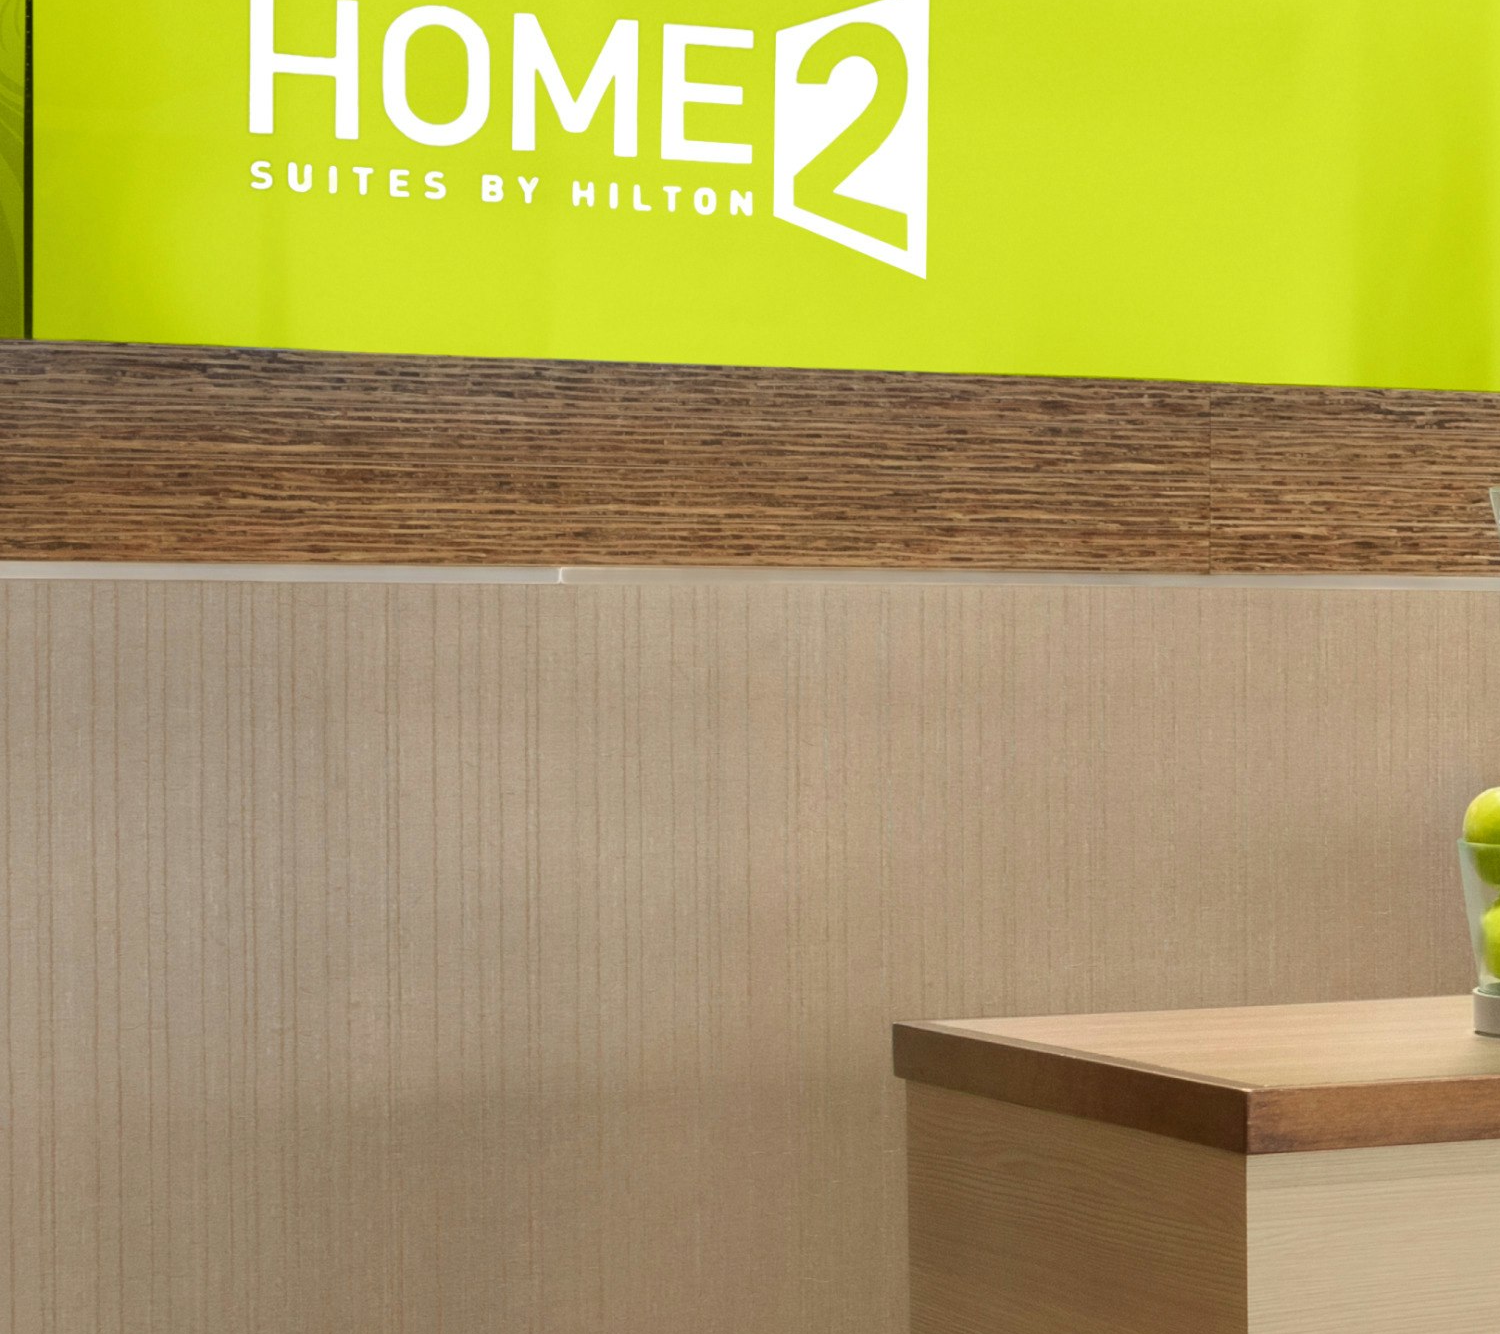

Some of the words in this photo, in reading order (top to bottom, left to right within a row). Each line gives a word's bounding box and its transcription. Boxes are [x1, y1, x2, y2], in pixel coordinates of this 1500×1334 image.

[250, 160, 448, 200] SUITES
[481, 174, 540, 205] BY
[572, 180, 754, 217] HILTON
